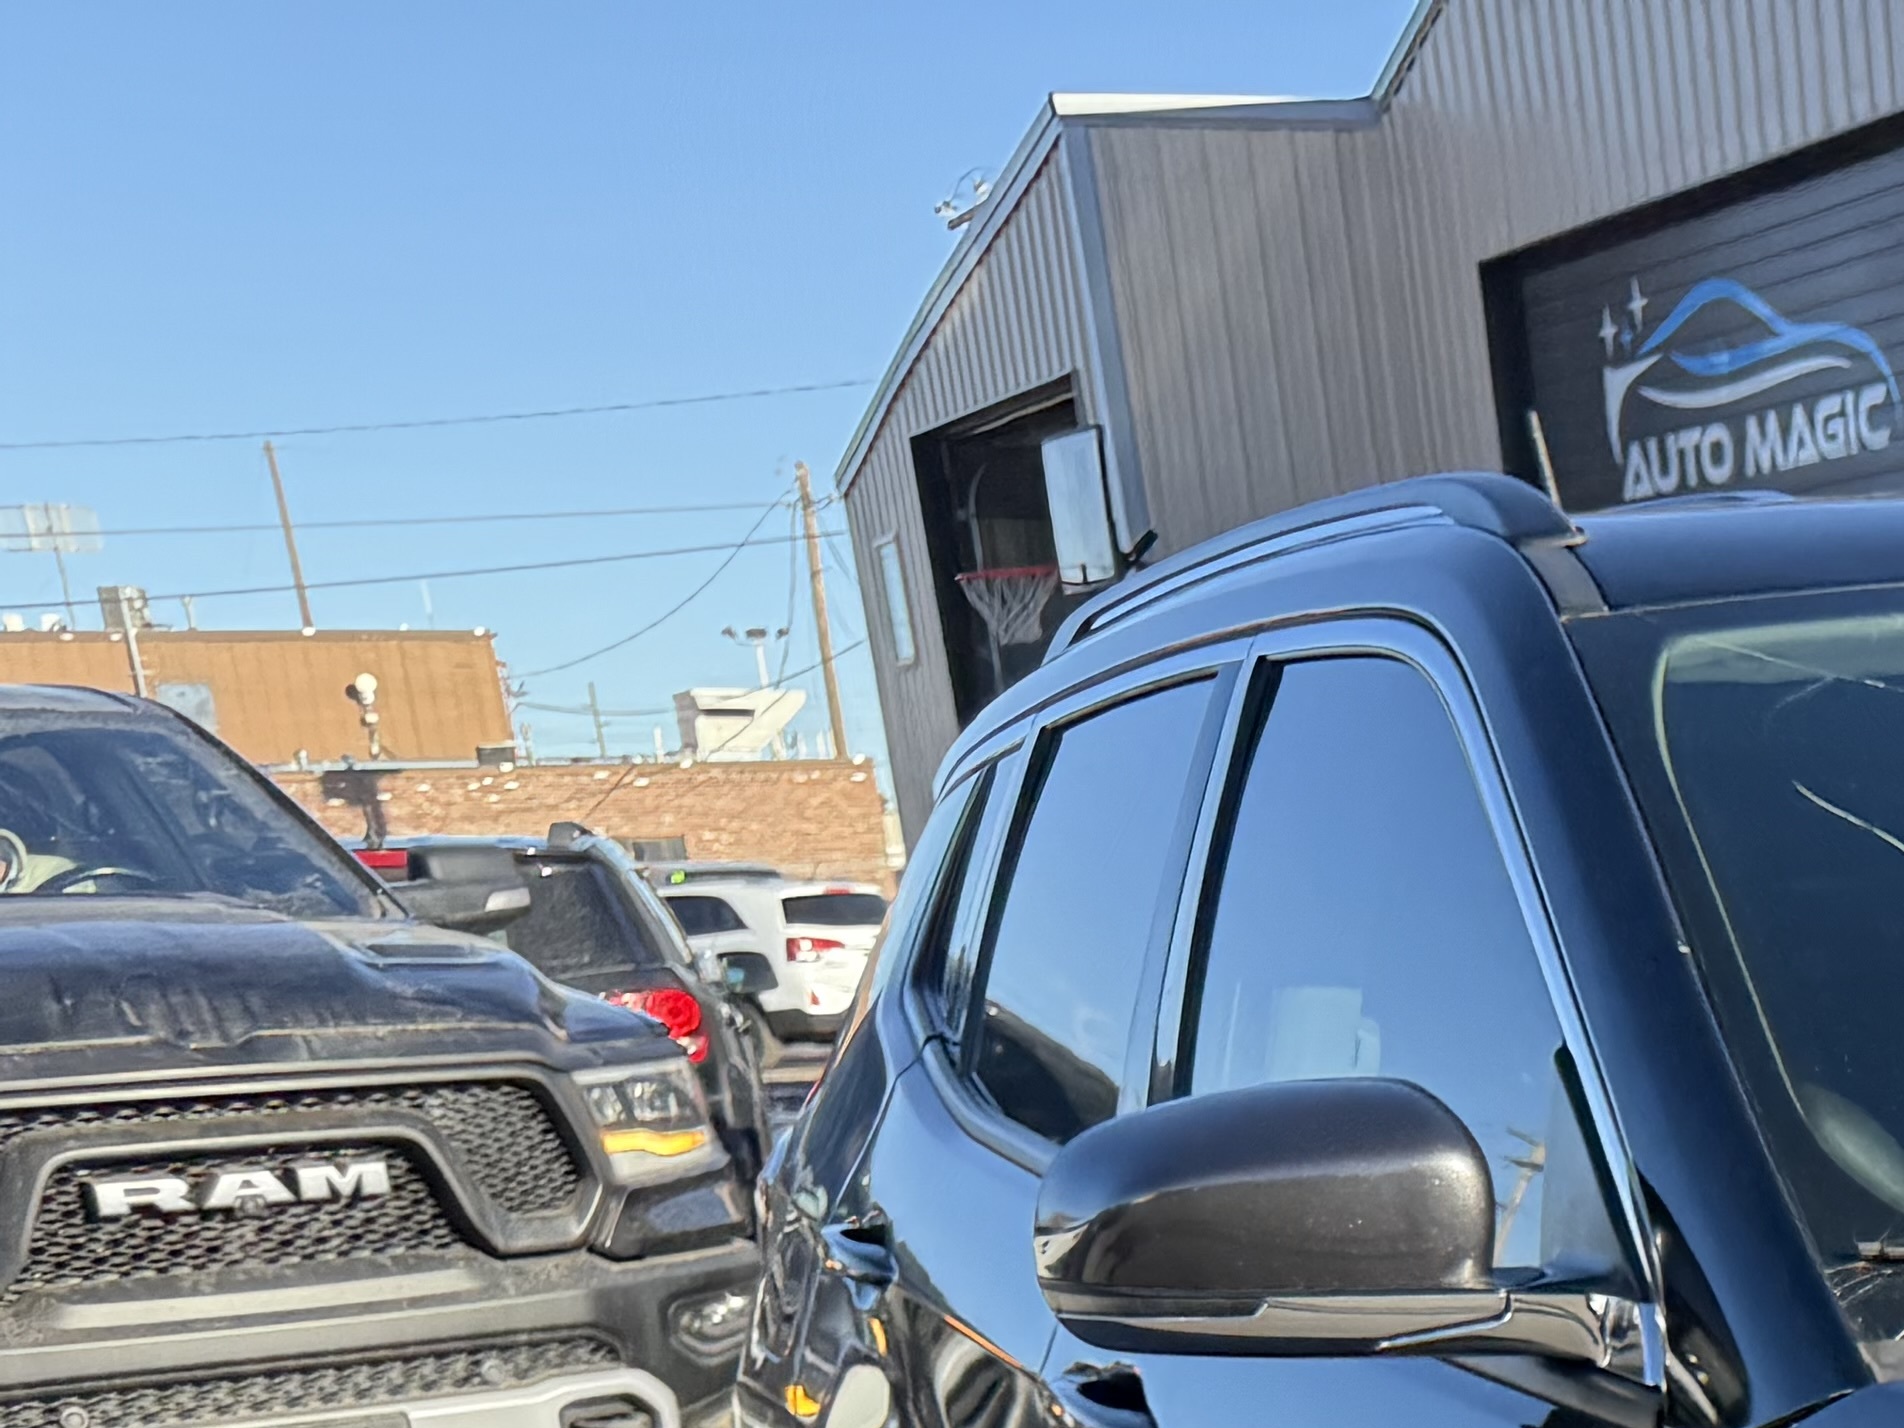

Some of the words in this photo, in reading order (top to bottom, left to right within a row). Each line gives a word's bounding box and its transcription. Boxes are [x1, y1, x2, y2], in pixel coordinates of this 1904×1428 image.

[1622, 421, 1735, 502] AUTO
[1743, 382, 1892, 478] MAGIC
[93, 1161, 392, 1218] RAM
